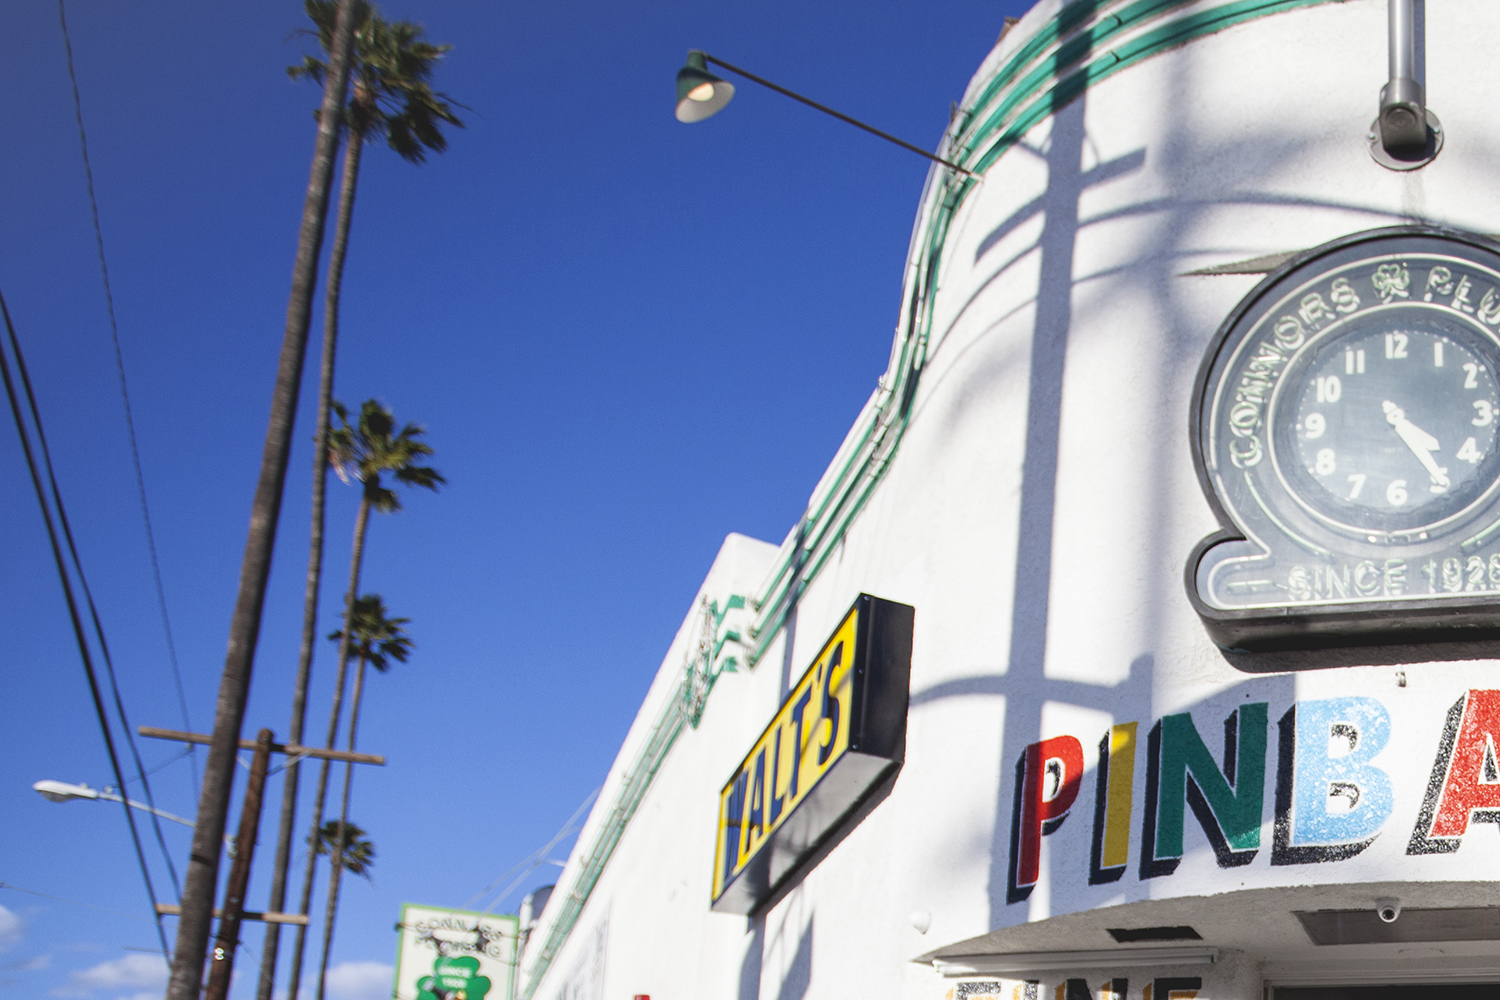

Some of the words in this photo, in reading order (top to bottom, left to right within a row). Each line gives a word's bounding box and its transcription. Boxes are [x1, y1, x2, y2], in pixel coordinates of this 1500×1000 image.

[1385, 333, 1408, 359] 12
[1230, 277, 1361, 469] CONNORS
[1345, 350, 1365, 375] 11
[1462, 362, 1478, 389] 2
[1316, 375, 1342, 403] 10
[1304, 412, 1327, 439] 9
[1471, 399, 1493, 427] 3
[1314, 448, 1336, 476] 8
[1456, 436, 1481, 464] 4
[1347, 473, 1367, 499] 7
[1386, 479, 1408, 506] 6
[1288, 558, 1408, 601] SINCE
[722, 640, 844, 881] WALT'S
